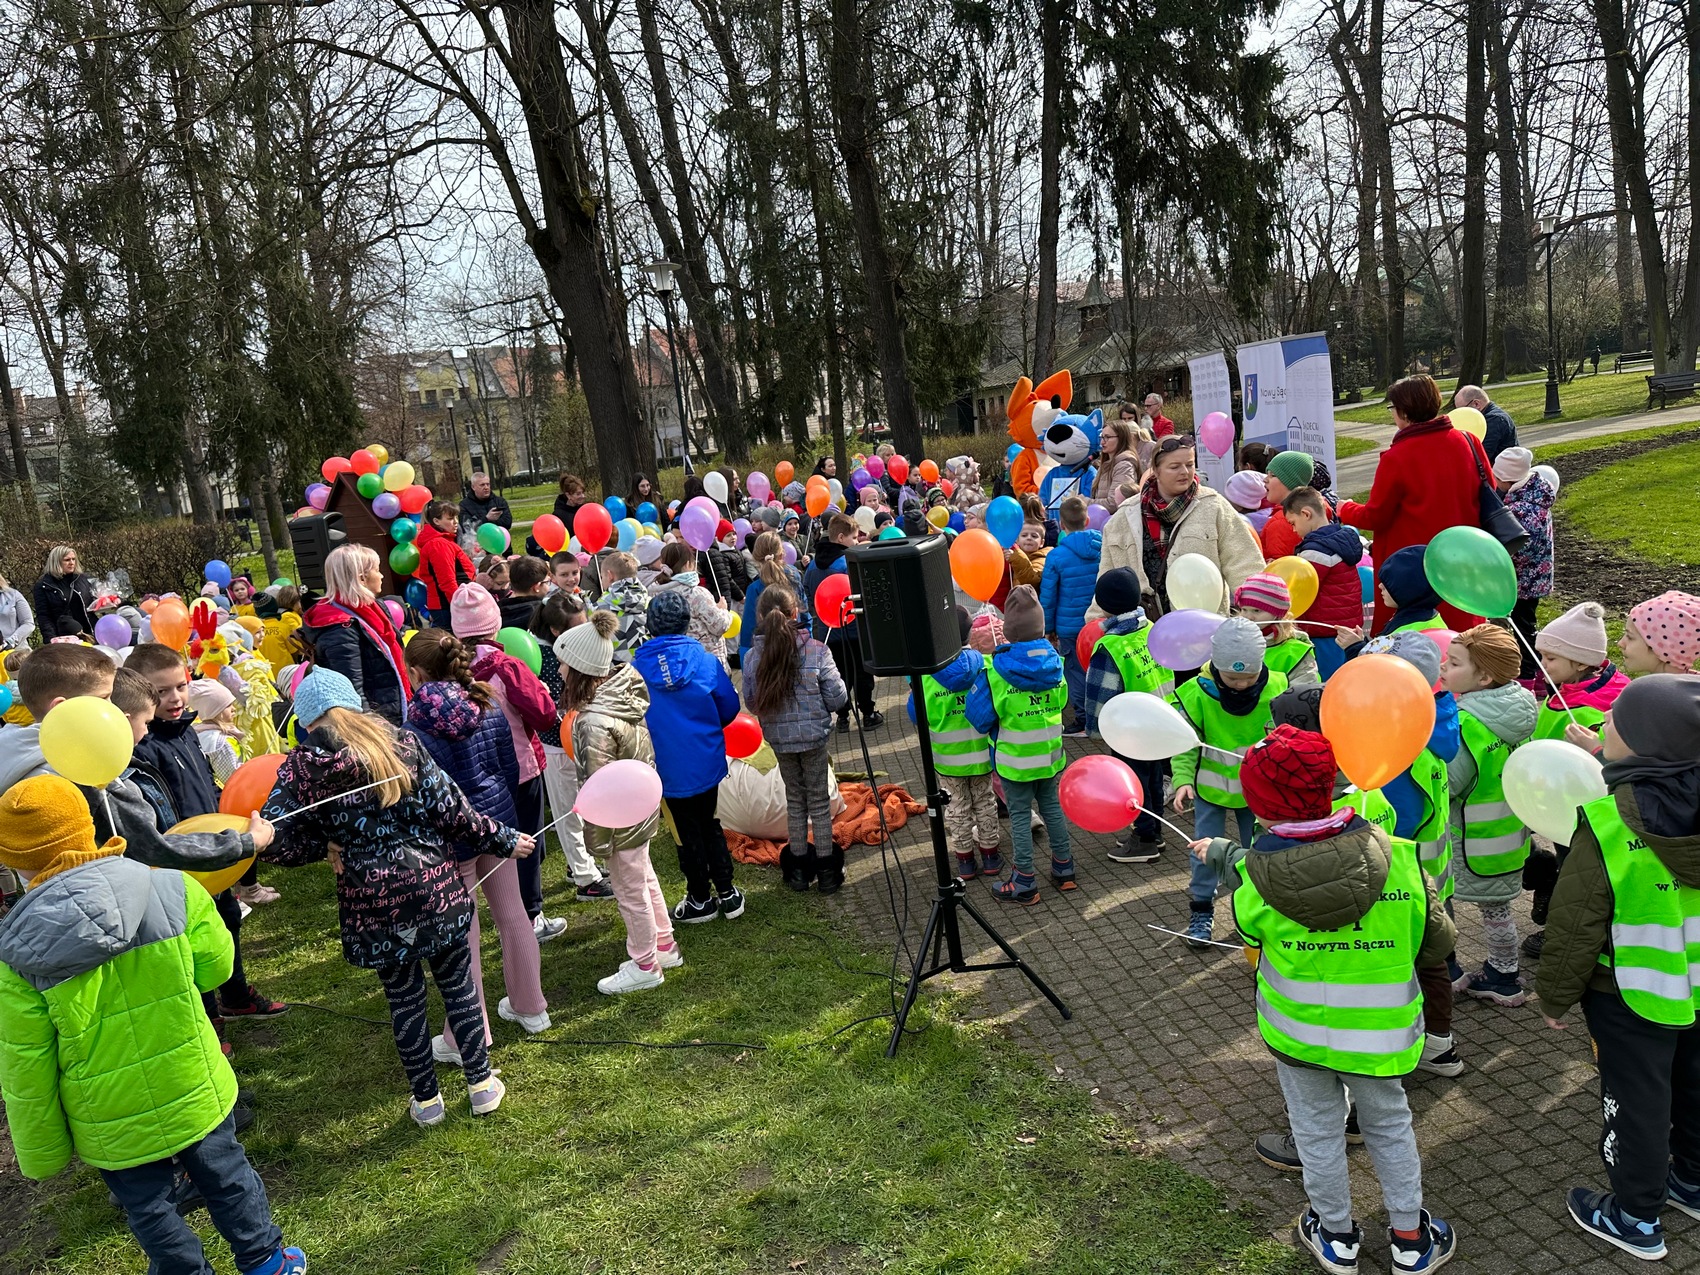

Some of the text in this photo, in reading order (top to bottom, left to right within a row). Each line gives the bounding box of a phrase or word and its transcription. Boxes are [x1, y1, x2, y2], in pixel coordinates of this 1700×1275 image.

[1261, 388, 1276, 399] Nowy
[1029, 693, 1051, 706] Nr 1
[331, 812, 349, 826] DO
[367, 822, 398, 840] LOVE
[365, 868, 389, 883] HEY
[421, 862, 447, 883] LOVE
[1655, 883, 1670, 892] w
[389, 892, 412, 906] LOVE
[422, 901, 436, 910] HEY
[432, 915, 445, 924] YOU
[458, 912, 470, 927] DO
[372, 940, 392, 956] DO
[1281, 939, 1396, 952] w Nowym Sączu
